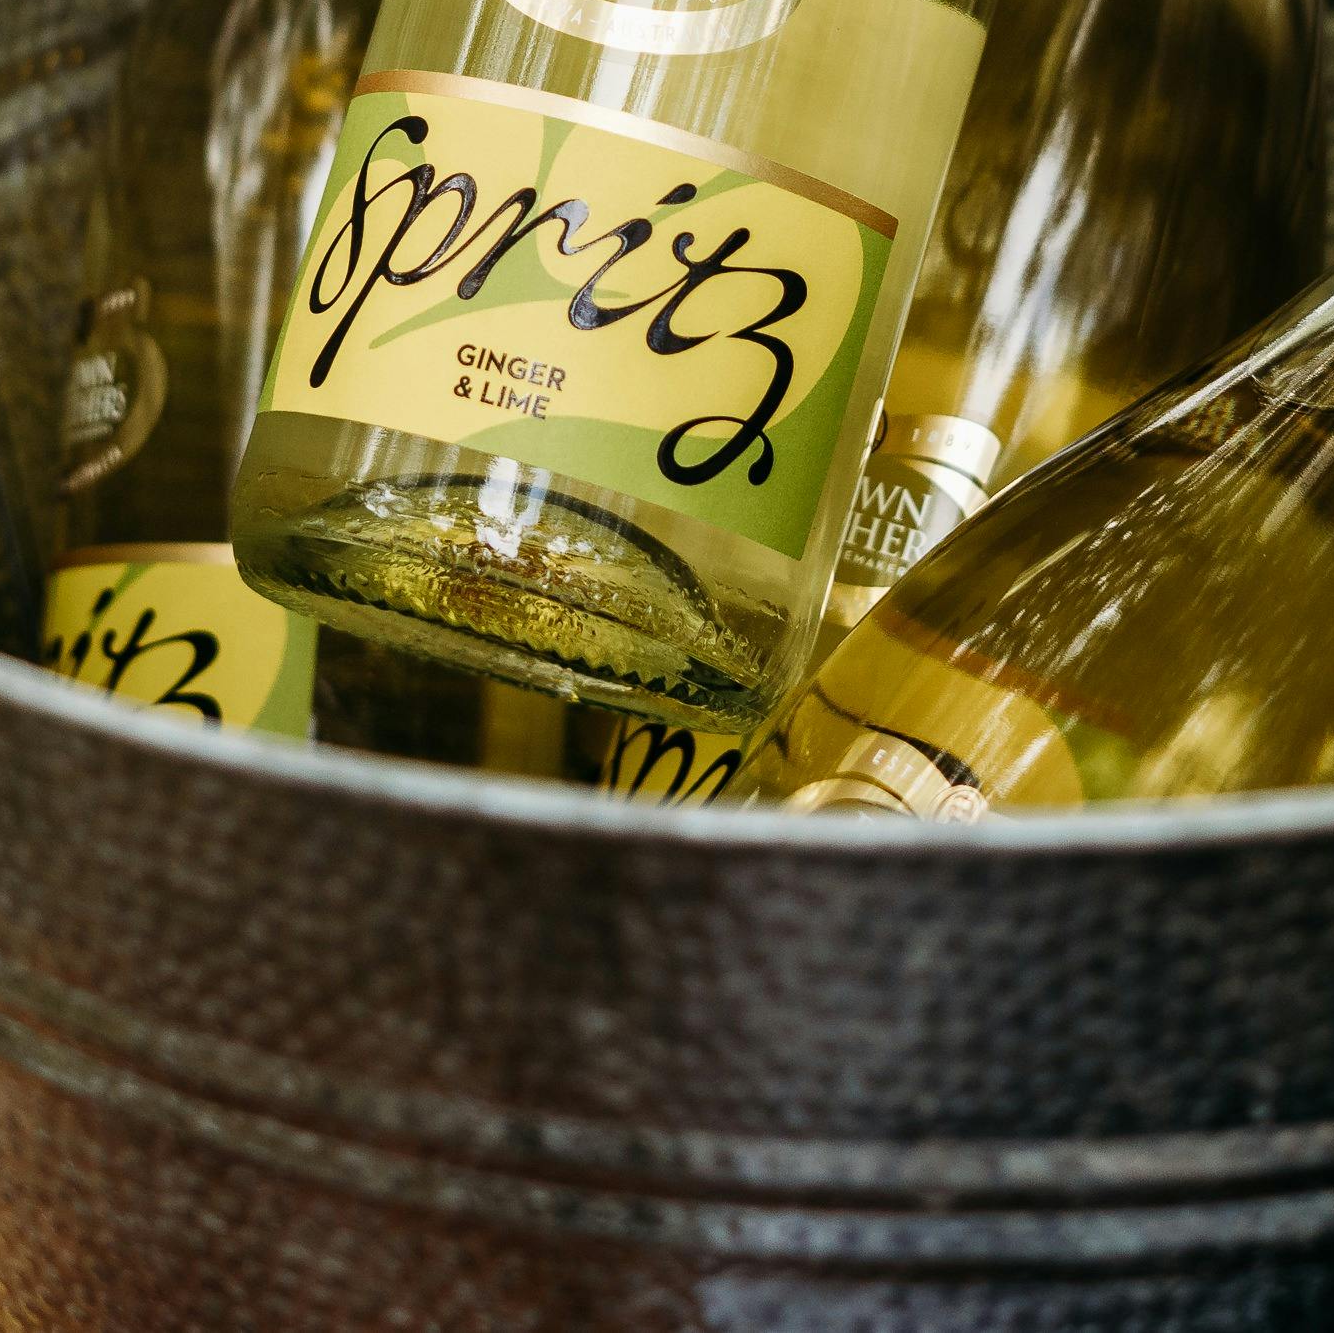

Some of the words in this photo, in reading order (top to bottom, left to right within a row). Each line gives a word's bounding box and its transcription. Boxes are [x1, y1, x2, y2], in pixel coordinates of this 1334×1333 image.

[309, 115, 808, 486] Spritz
[457, 343, 567, 392] GINGER
[454, 375, 475, 400] &
[479, 380, 551, 420] LIME
